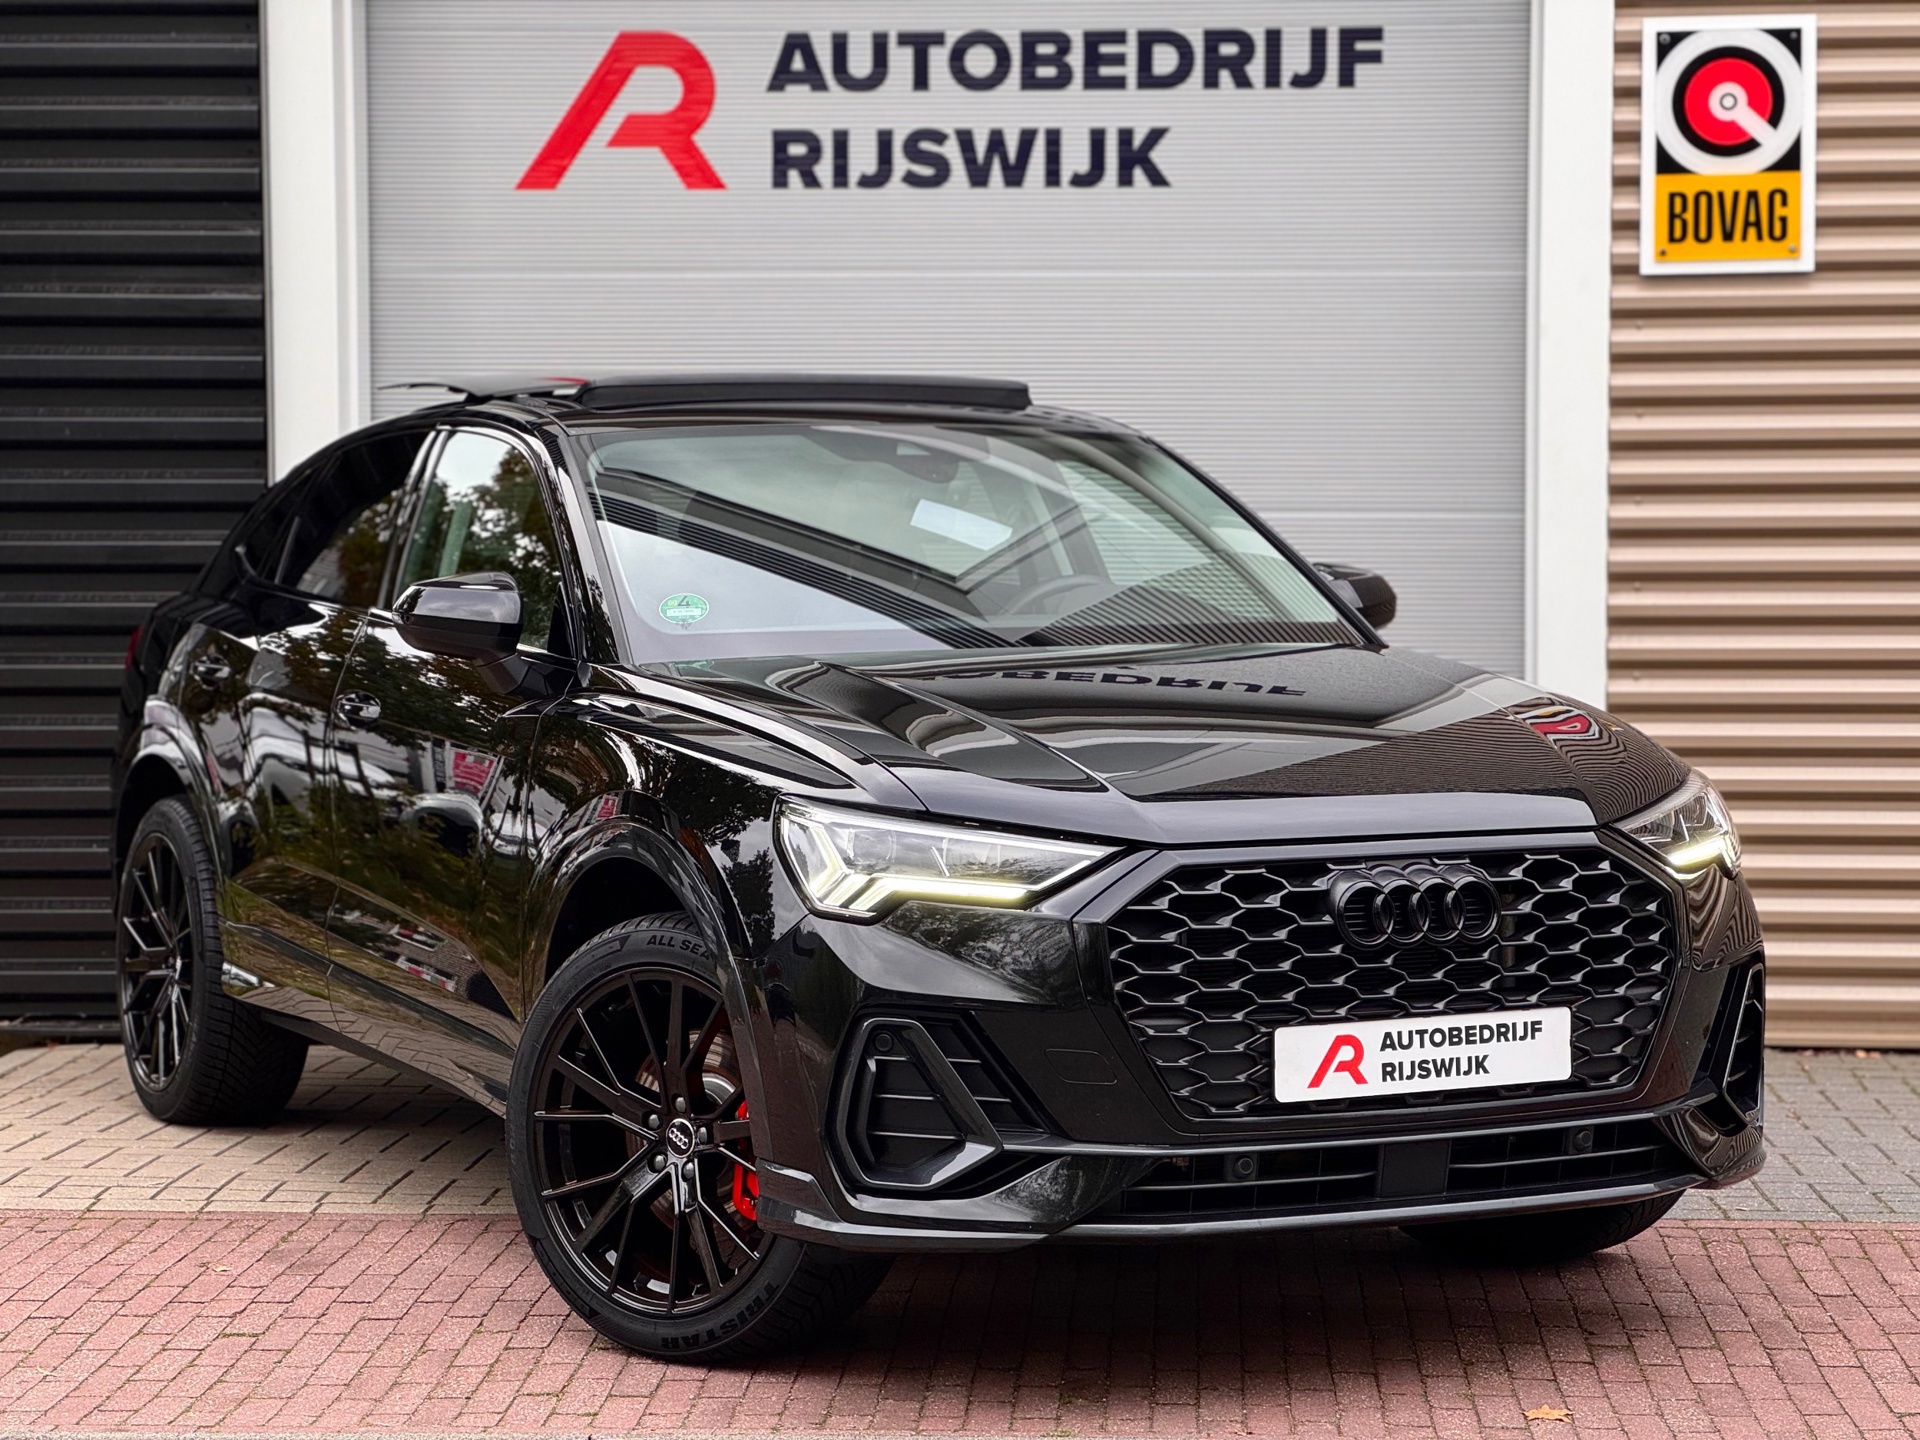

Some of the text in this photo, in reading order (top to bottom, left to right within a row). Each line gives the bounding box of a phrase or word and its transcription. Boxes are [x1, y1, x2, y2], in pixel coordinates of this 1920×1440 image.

[767, 27, 1384, 92] AUTOBEDRIJF
[770, 127, 1171, 188] RIJSWIJK
[1668, 187, 1788, 244] BOVAG
[646, 934, 676, 948] ALL
[1380, 1020, 1543, 1052] AUTOBEDRIJF
[1381, 1054, 1490, 1082] RIJSWIJK
[660, 1281, 780, 1349] TRISTAR
